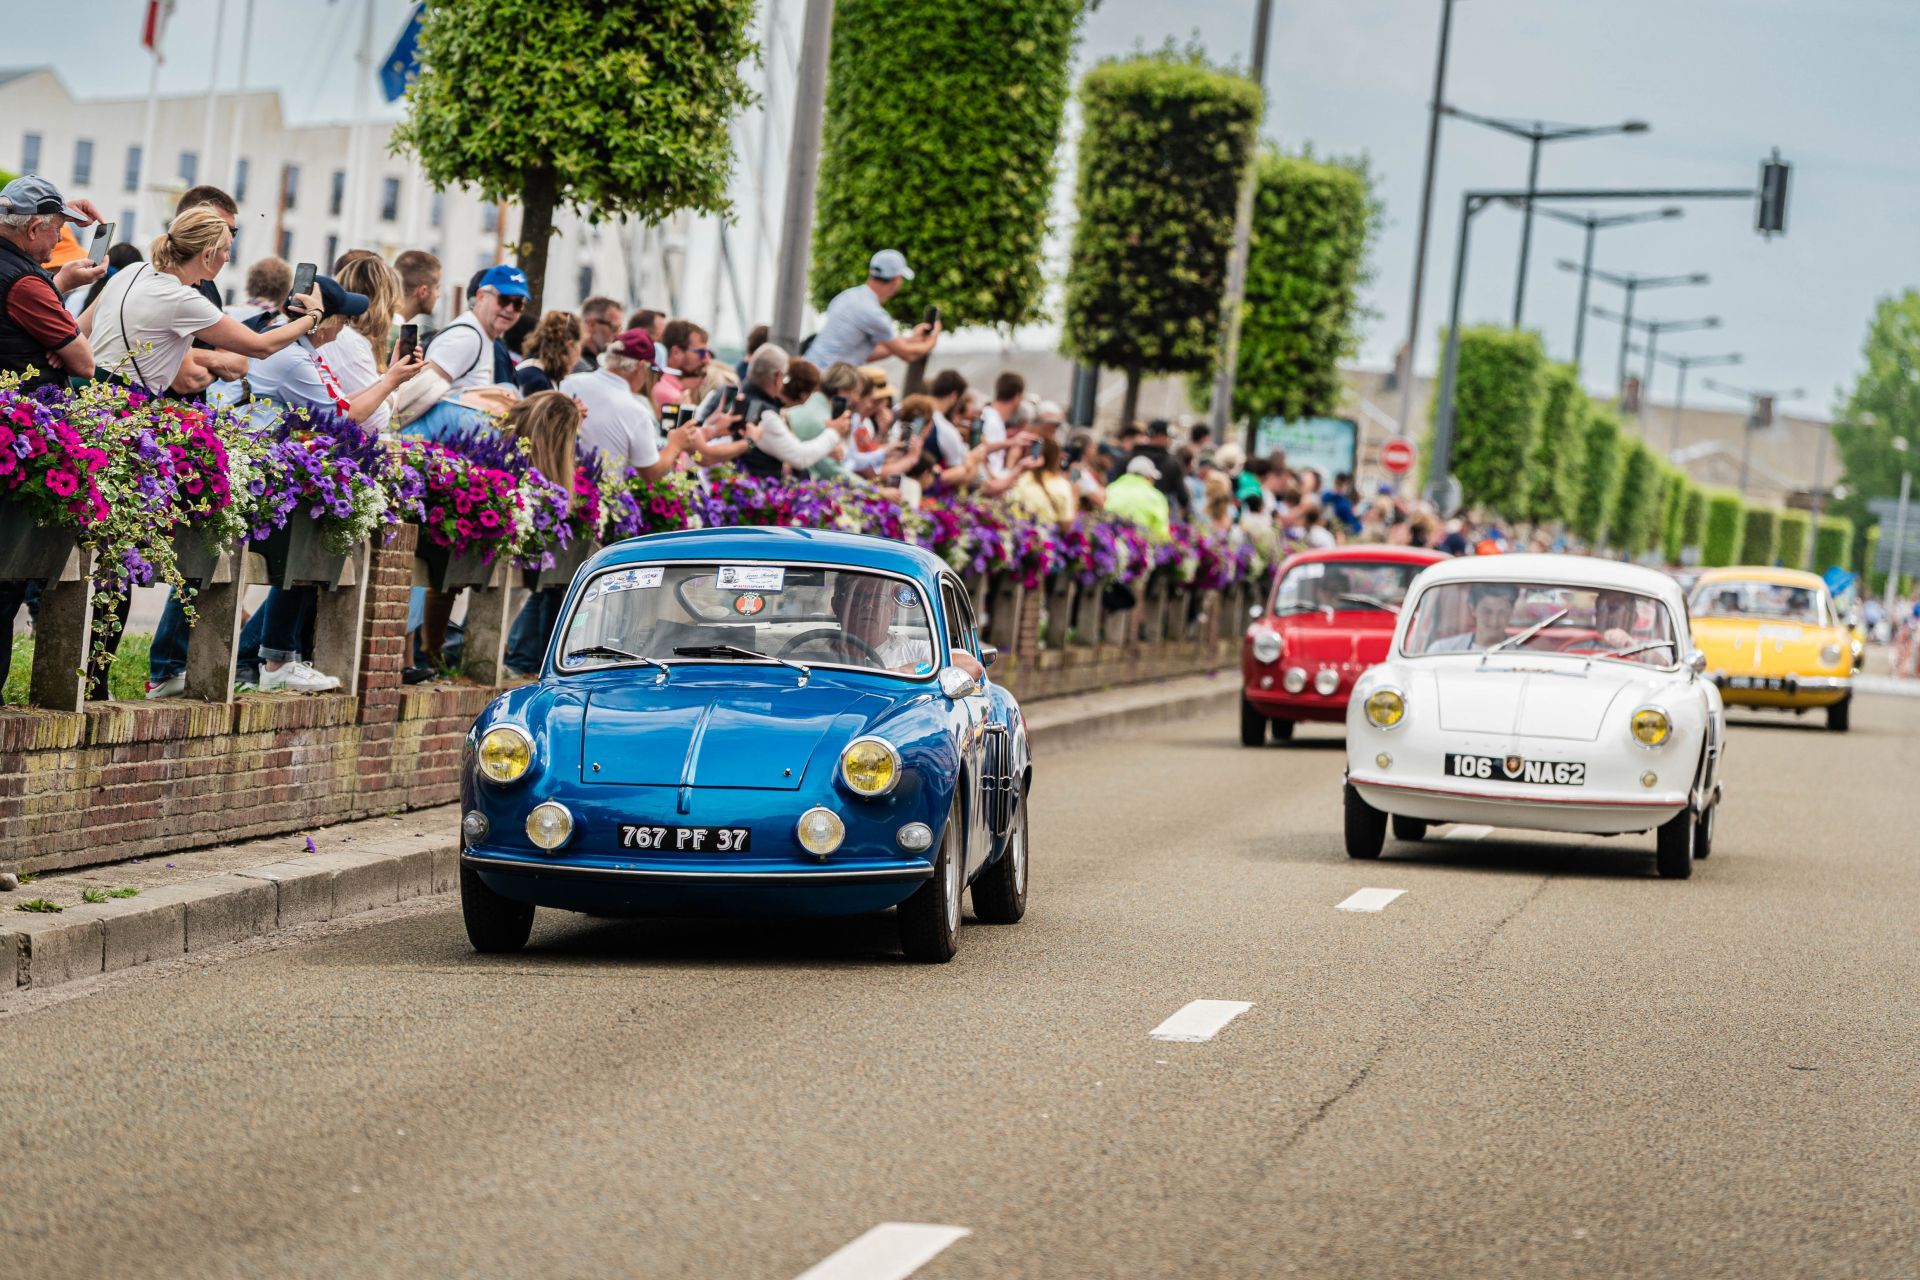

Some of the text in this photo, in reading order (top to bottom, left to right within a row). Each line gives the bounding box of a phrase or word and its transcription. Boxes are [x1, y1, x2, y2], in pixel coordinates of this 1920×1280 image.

[1453, 754, 1585, 785] 106 NA62
[622, 825, 748, 851] 767 PF 37
